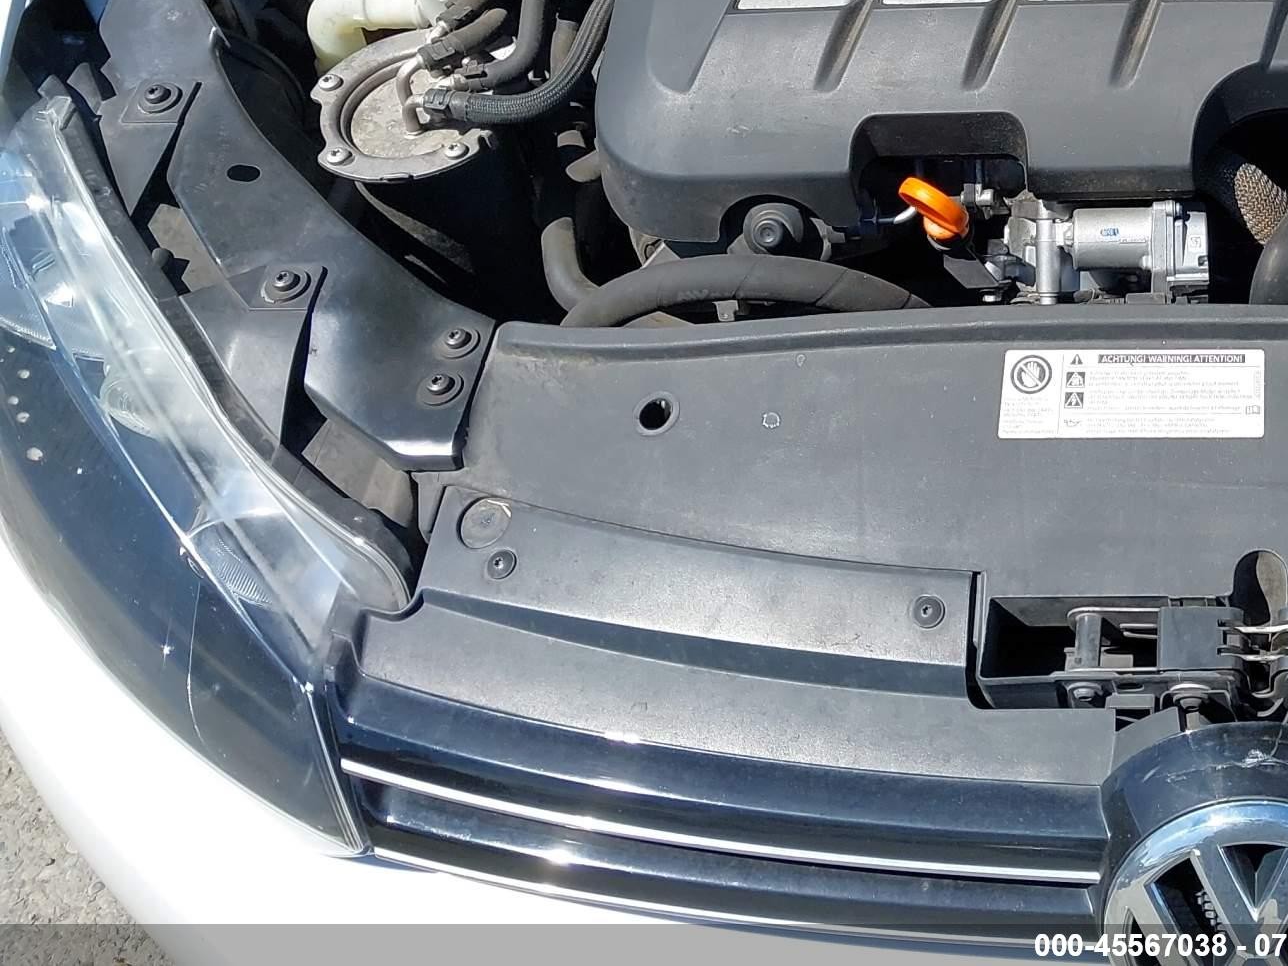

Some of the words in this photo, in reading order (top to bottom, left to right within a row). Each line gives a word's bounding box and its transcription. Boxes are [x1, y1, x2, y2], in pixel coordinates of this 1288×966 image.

[1101, 354, 1146, 364] ACHTUNG!
[1148, 354, 1193, 364] WARNING!
[1194, 354, 1243, 364] ATTENTION!
